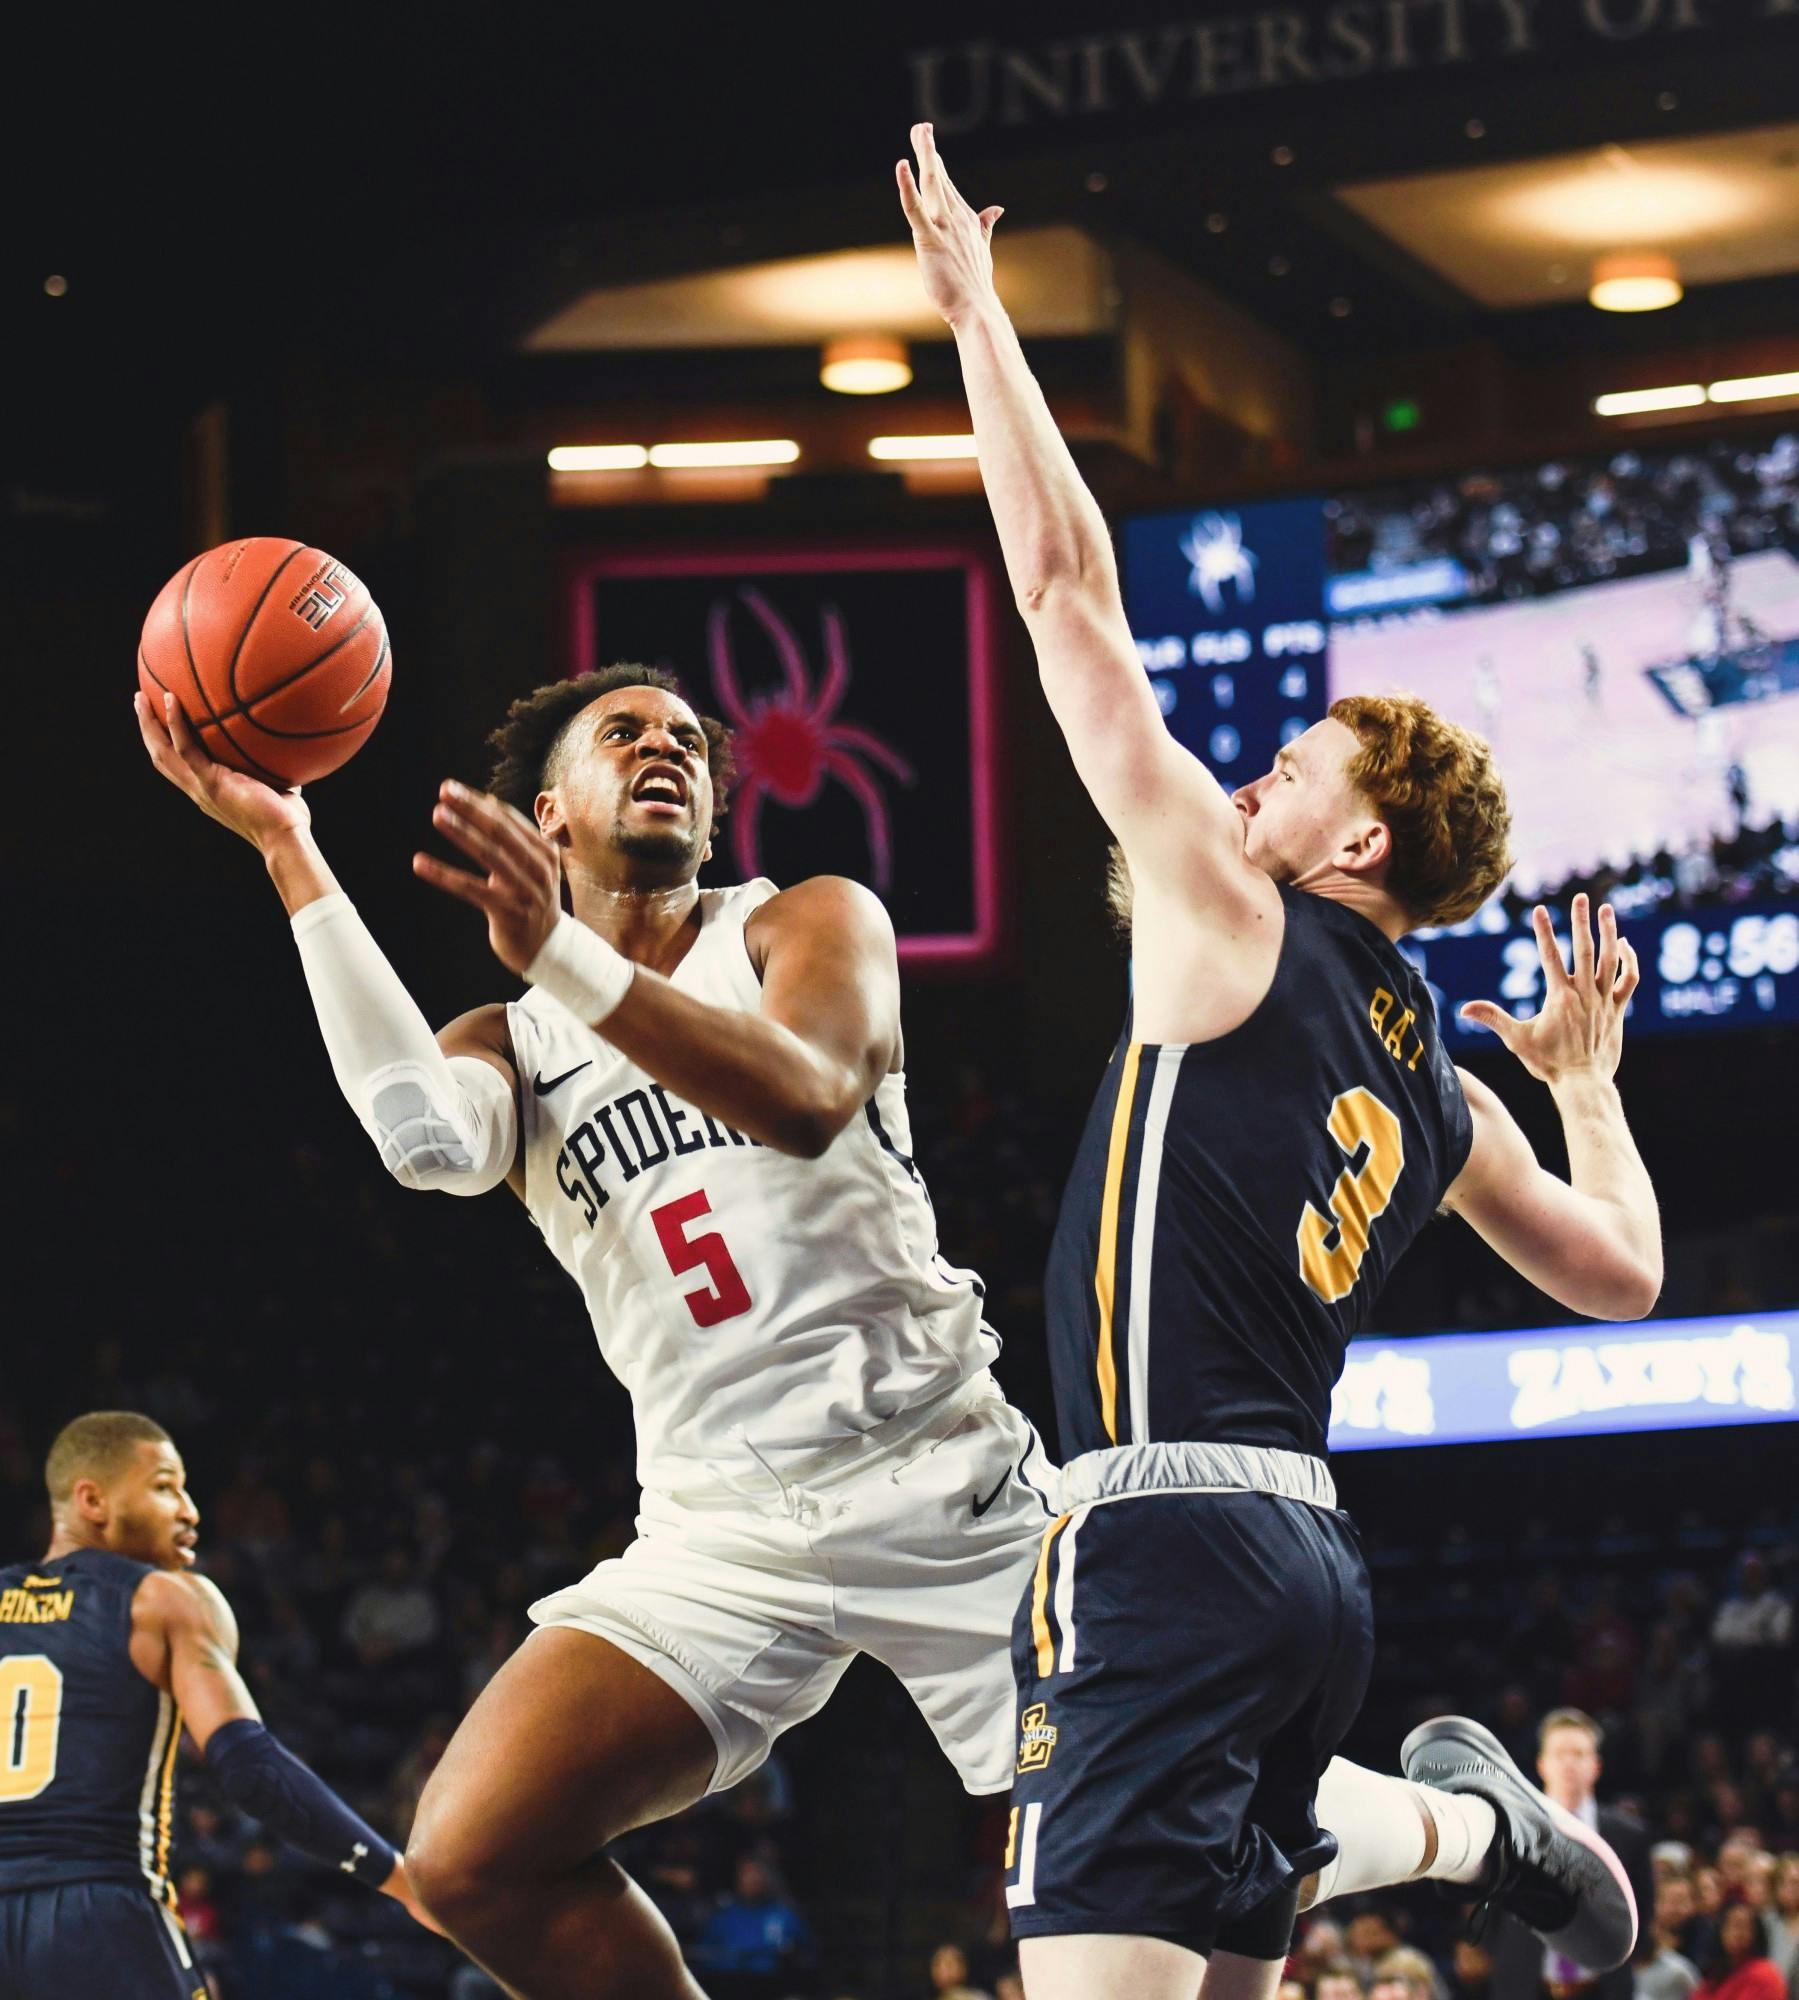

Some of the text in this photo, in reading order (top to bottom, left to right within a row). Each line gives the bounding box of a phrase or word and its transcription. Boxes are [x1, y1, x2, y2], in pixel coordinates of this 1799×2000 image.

[910, 0, 1538, 136] UNIVERSITY
[556, 1083, 763, 1230] SPIDE
[1297, 1086, 1404, 1304] 3
[650, 1188, 752, 1328] 5
[0, 1654, 64, 1803] 0
